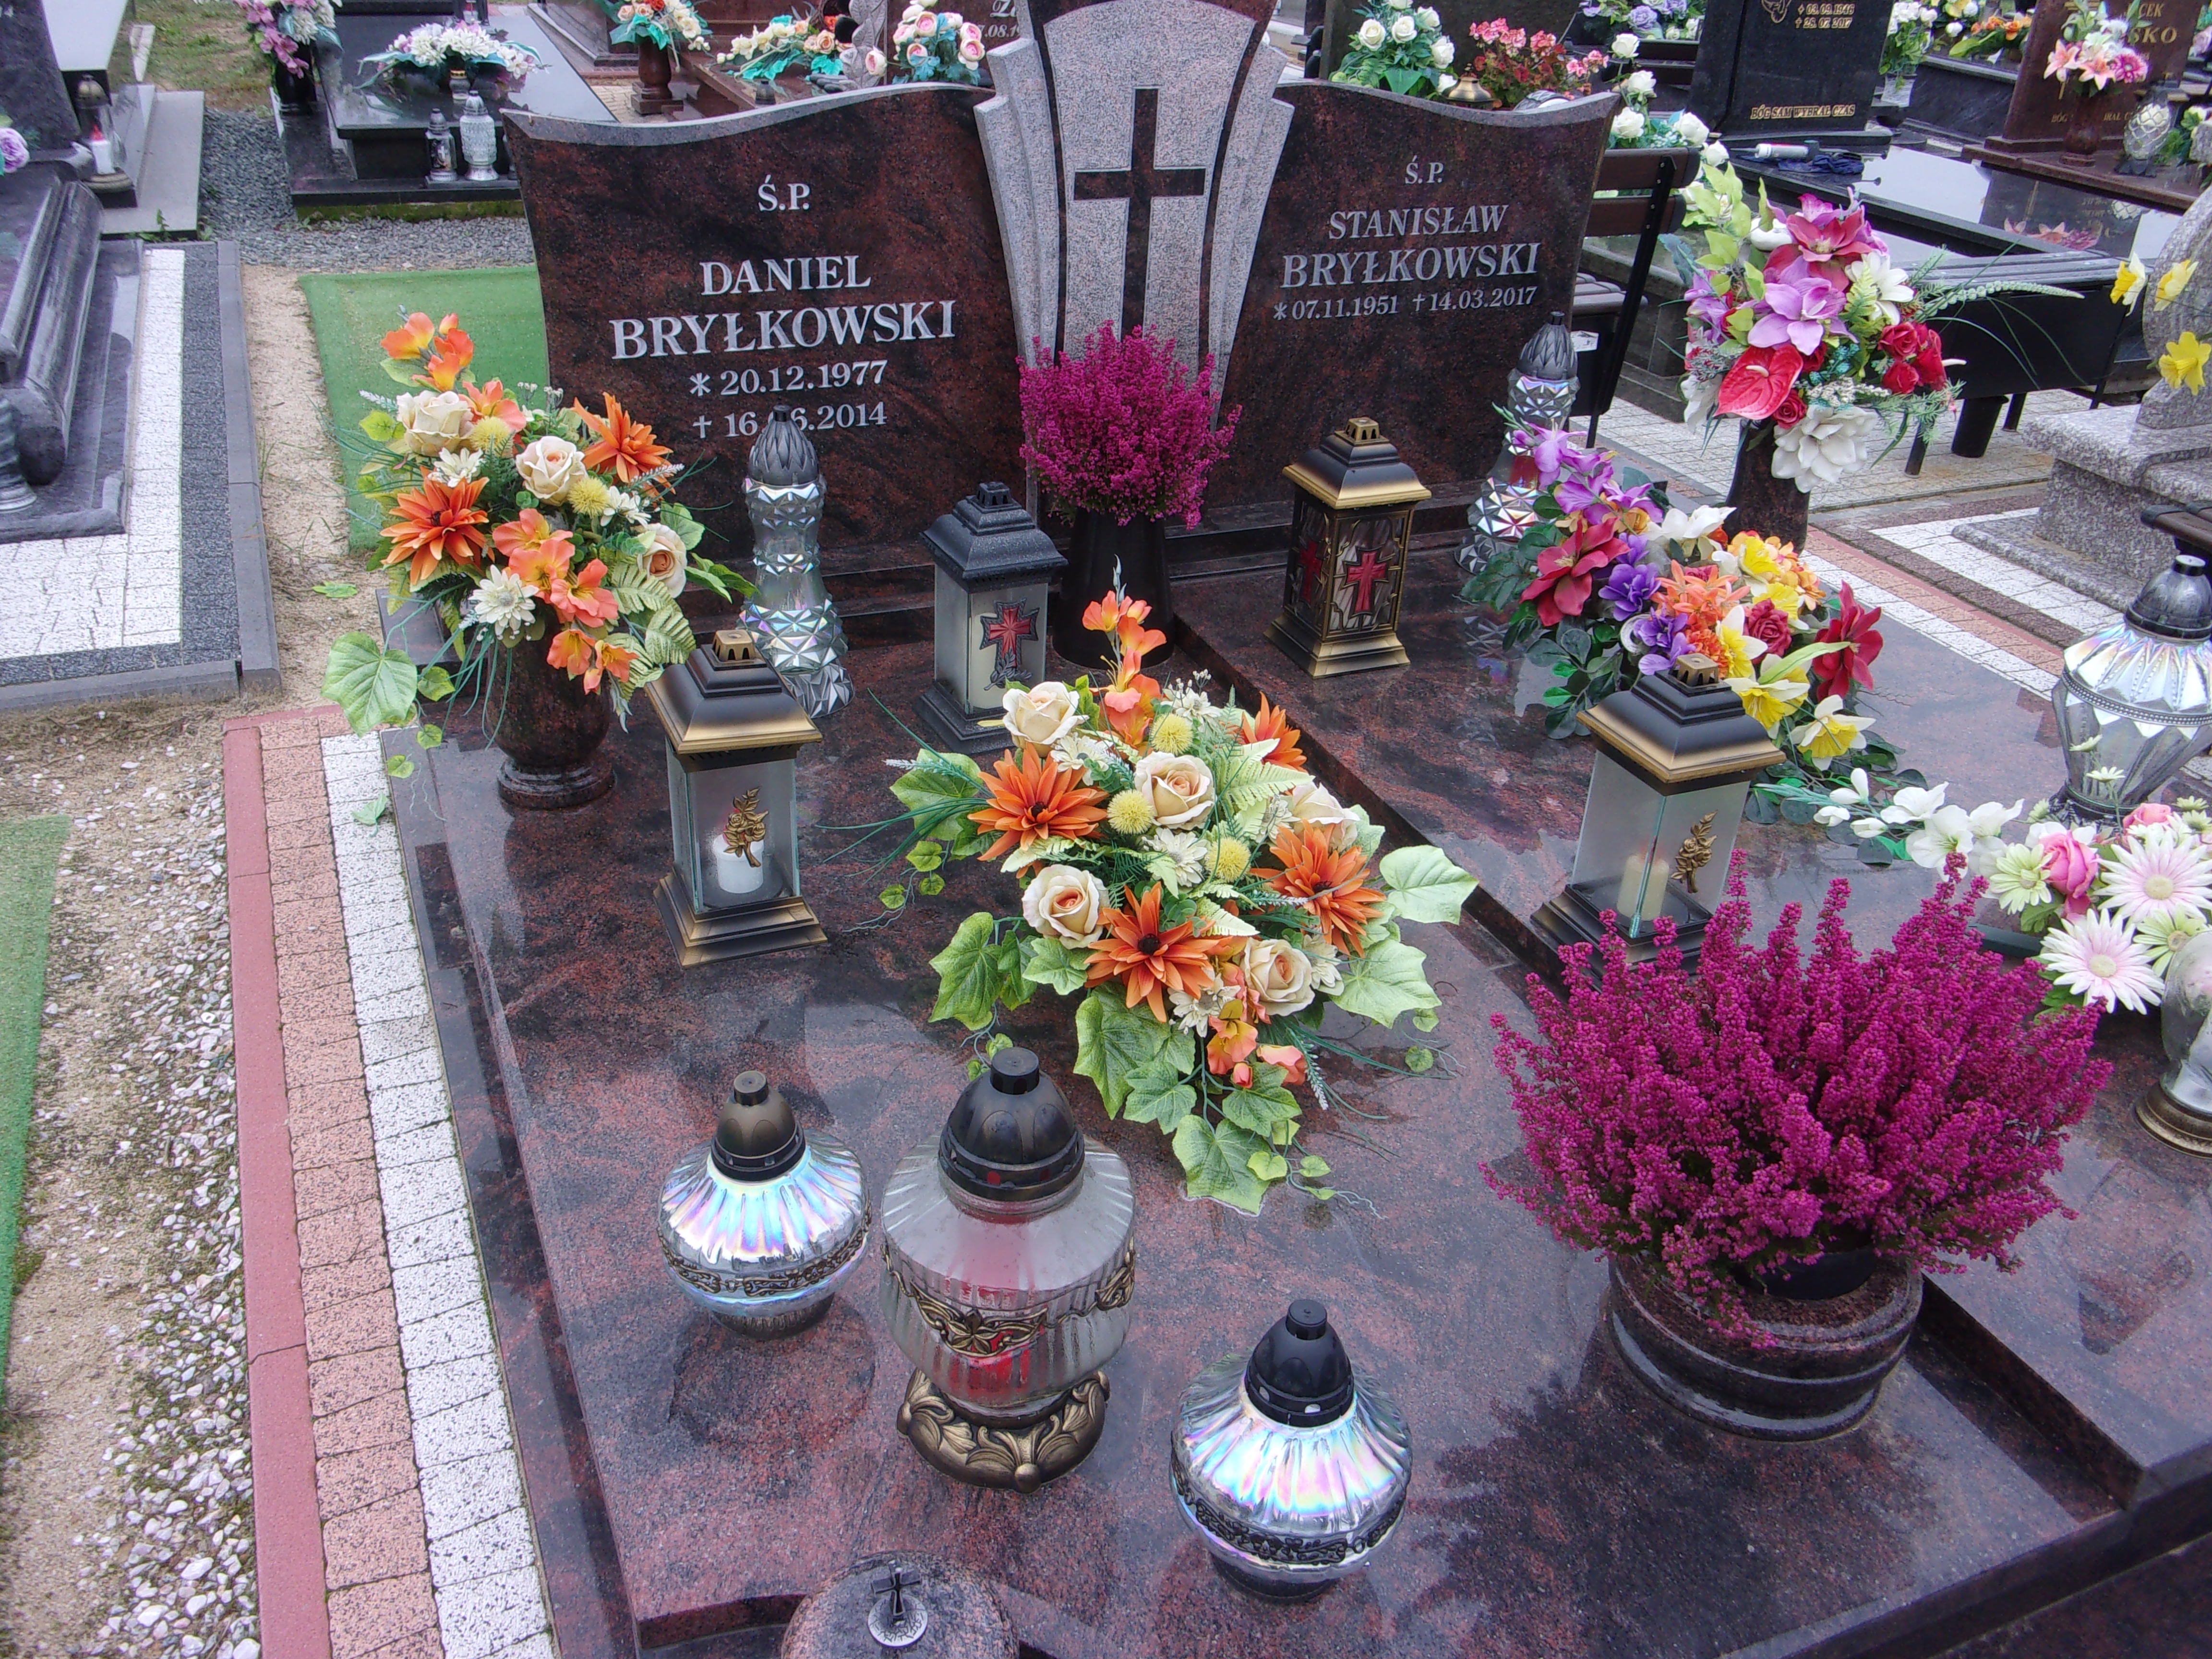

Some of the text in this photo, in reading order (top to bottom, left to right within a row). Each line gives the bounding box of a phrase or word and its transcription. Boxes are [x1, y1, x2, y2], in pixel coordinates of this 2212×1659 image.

[2138, 3, 2164, 17] CEK
[2128, 27, 2177, 44] SKO
[1750, 104, 1856, 119] BÓG SAM WYBRAŁ CZAS
[757, 175, 810, 212] Ś.P.
[1329, 204, 1509, 240] STANISŁAW
[699, 255, 871, 295] DANIEL
[1280, 242, 1541, 288] BRYŁKOWSKI
[1292, 286, 1538, 320] 07.11.1951 14.03.2017
[608, 300, 957, 360] BRYŁKOWSKI
[721, 360, 888, 396] 20.12.1977
[724, 401, 887, 437] 166.2014
